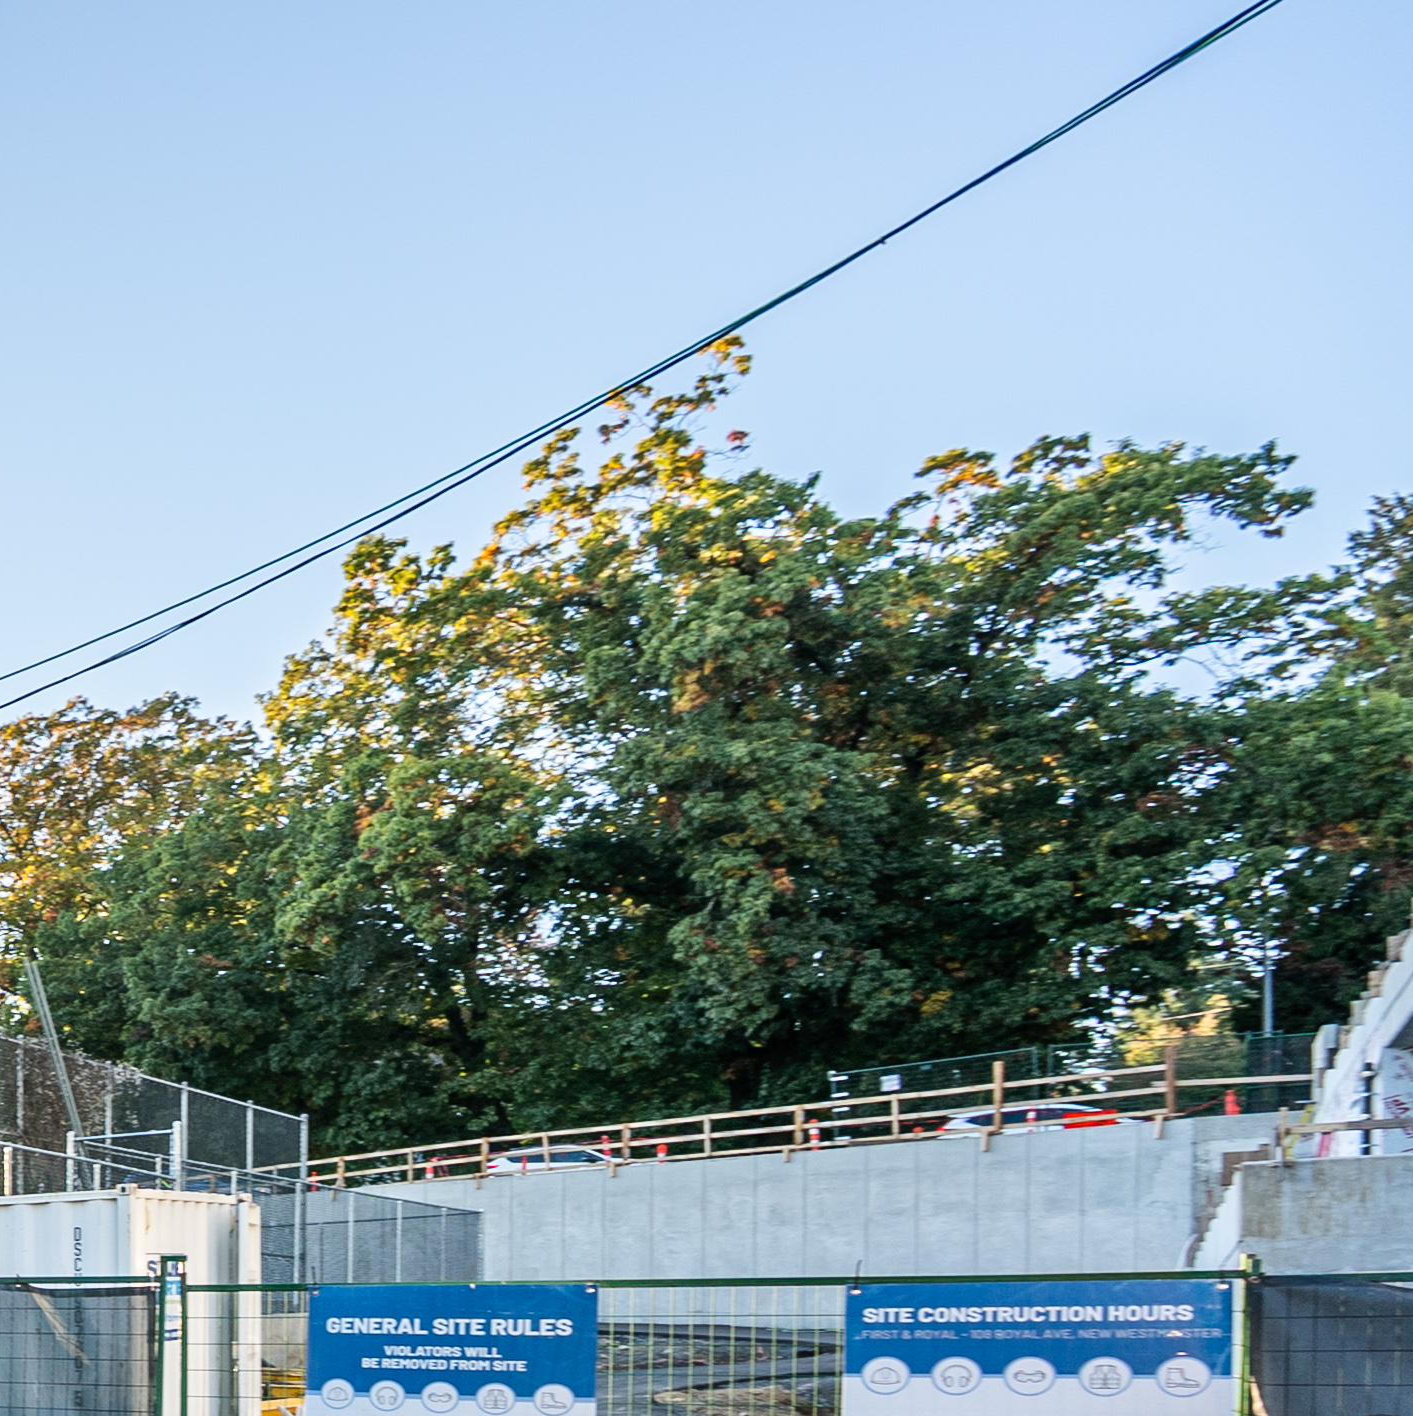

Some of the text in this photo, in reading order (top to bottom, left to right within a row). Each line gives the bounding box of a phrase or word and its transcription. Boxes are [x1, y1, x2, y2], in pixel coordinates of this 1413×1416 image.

[862, 1304, 1195, 1324] SITE CONSTRUCTION HOURS
[325, 1317, 573, 1336] GENERAL SITE RULES
[860, 1330, 899, 1340] FIRST
[900, 1330, 911, 1340] &
[913, 1330, 959, 1340] ROYAL
[993, 1329, 1040, 1339] ROYAL
[1077, 1328, 1111, 1338] NEW
[1114, 1328, 1223, 1339] WESTMSTER
[383, 1345, 503, 1358] VIOLATORS WILL
[361, 1357, 528, 1372] BE REMOVED FROM SITE
